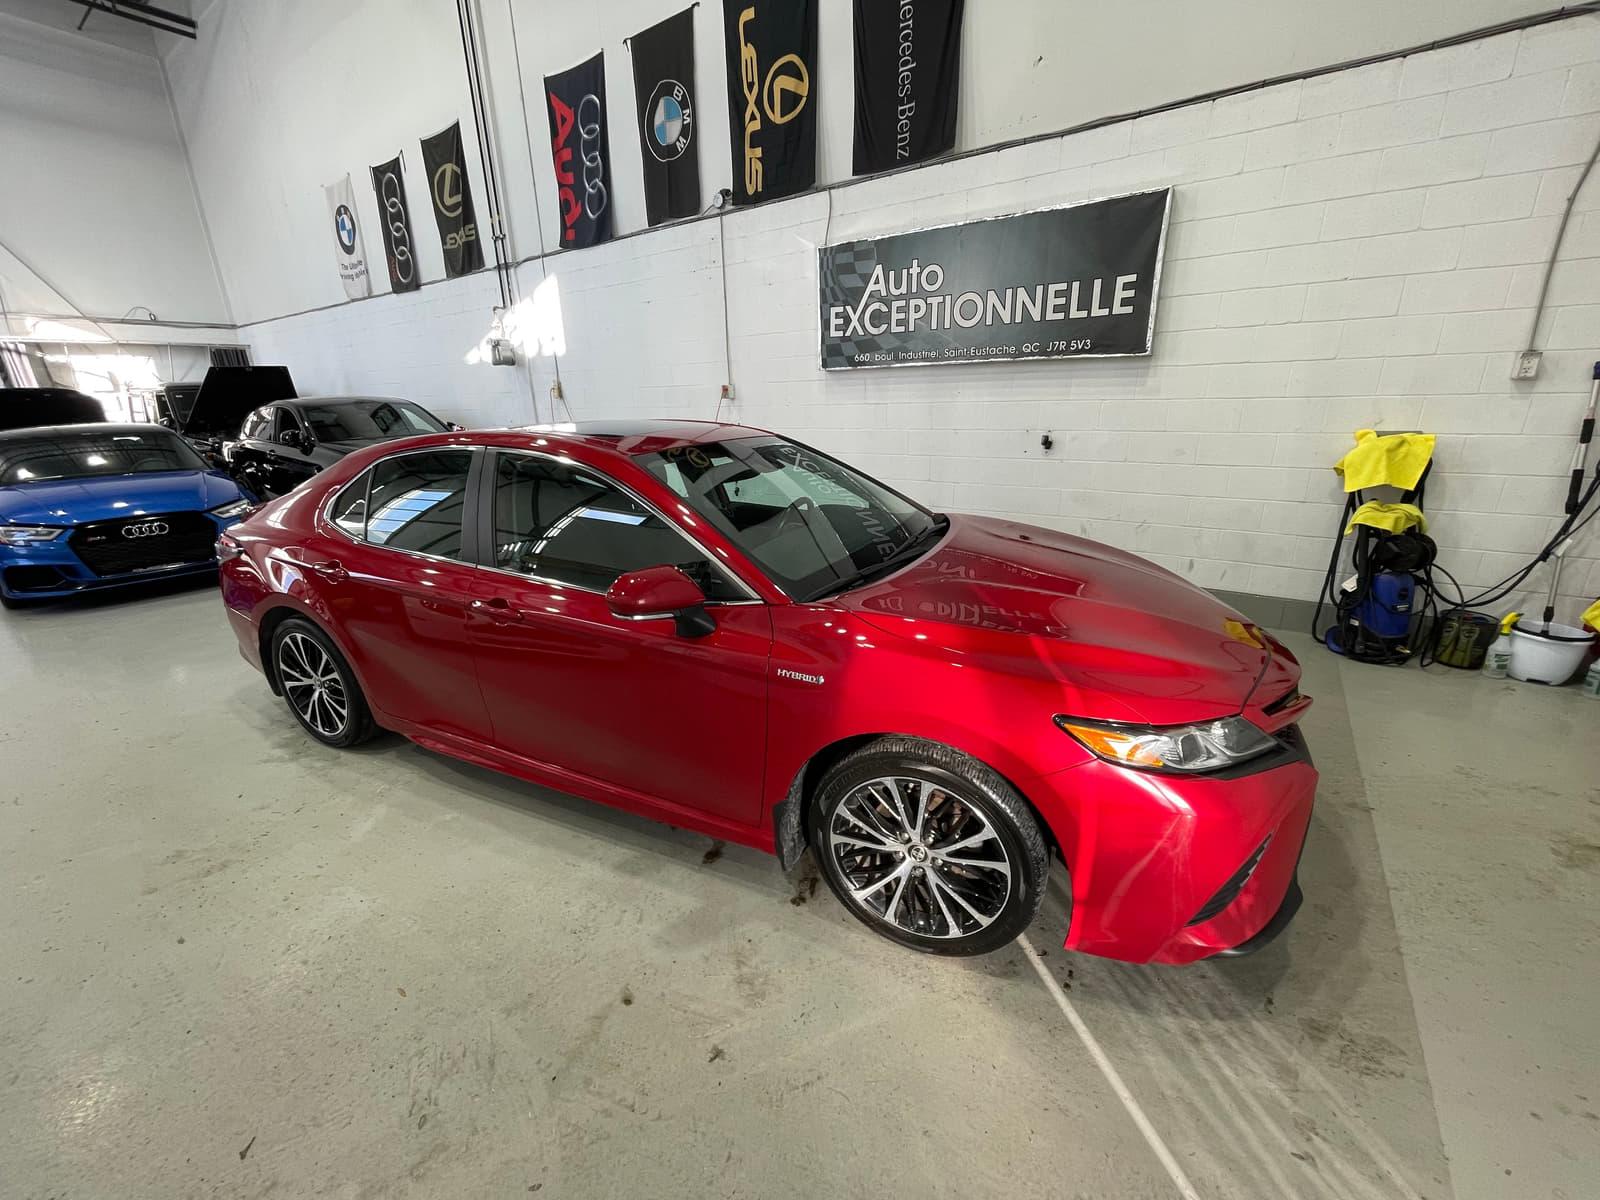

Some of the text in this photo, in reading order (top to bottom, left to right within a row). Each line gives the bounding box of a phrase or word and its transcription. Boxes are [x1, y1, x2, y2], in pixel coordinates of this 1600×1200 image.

[672, 85, 691, 151] BMW
[738, 6, 763, 195] LEXUS
[443, 223, 476, 249] EXS
[866, 258, 945, 298] Auto
[829, 273, 1138, 338] EXCEPTIONNELLE
[1022, 342, 1041, 354] QC
[1047, 340, 1068, 353] J7R
[1070, 338, 1092, 351] 5V3
[777, 668, 817, 684] HYBRID
